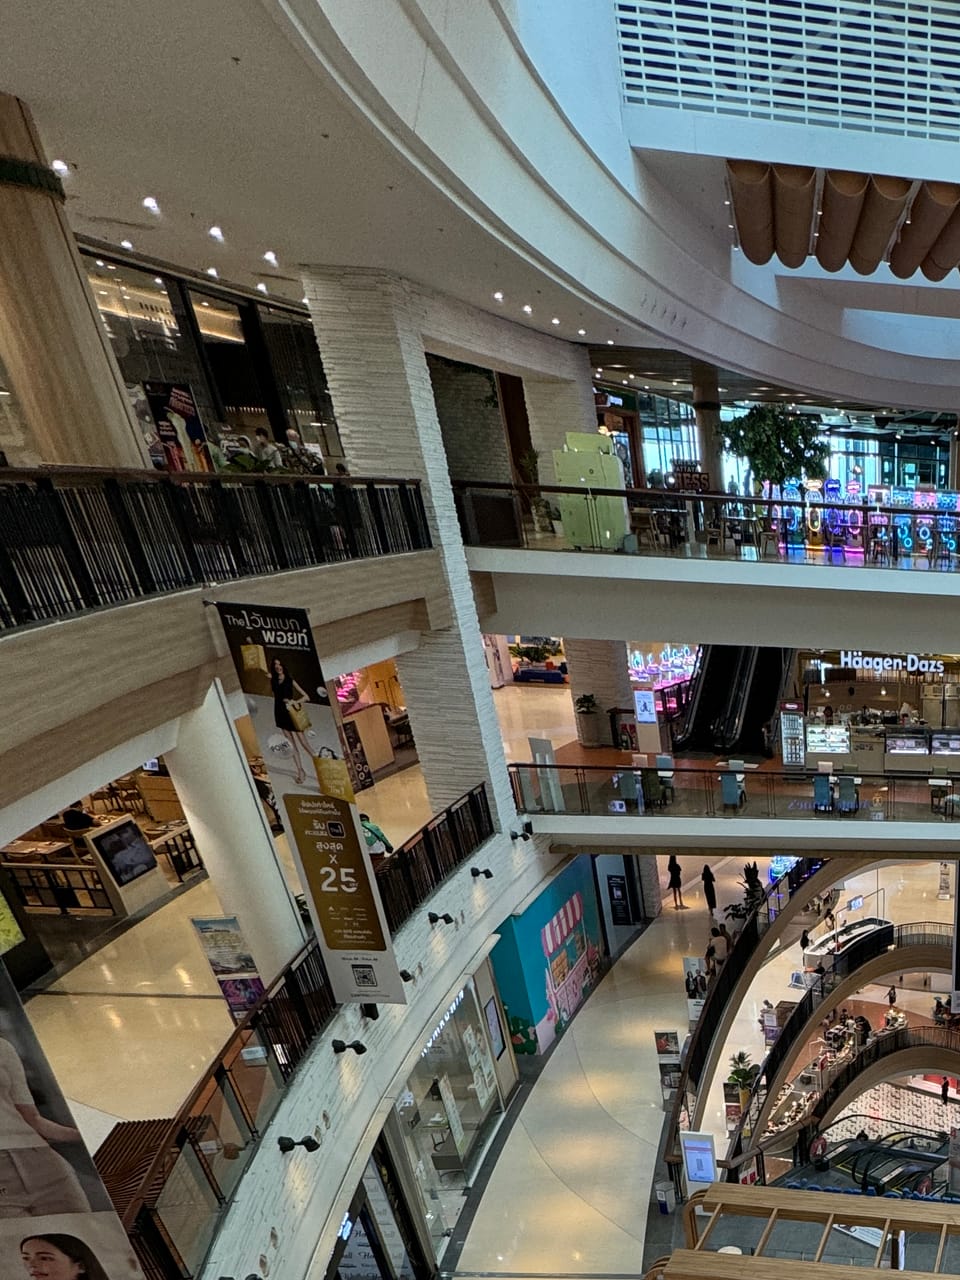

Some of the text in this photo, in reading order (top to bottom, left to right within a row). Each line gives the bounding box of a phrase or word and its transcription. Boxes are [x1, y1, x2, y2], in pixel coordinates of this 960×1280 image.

[840, 650, 945, 673] Häagen-Dazs
[316, 841, 344, 853] สูงสุด
[320, 866, 358, 893] 25
